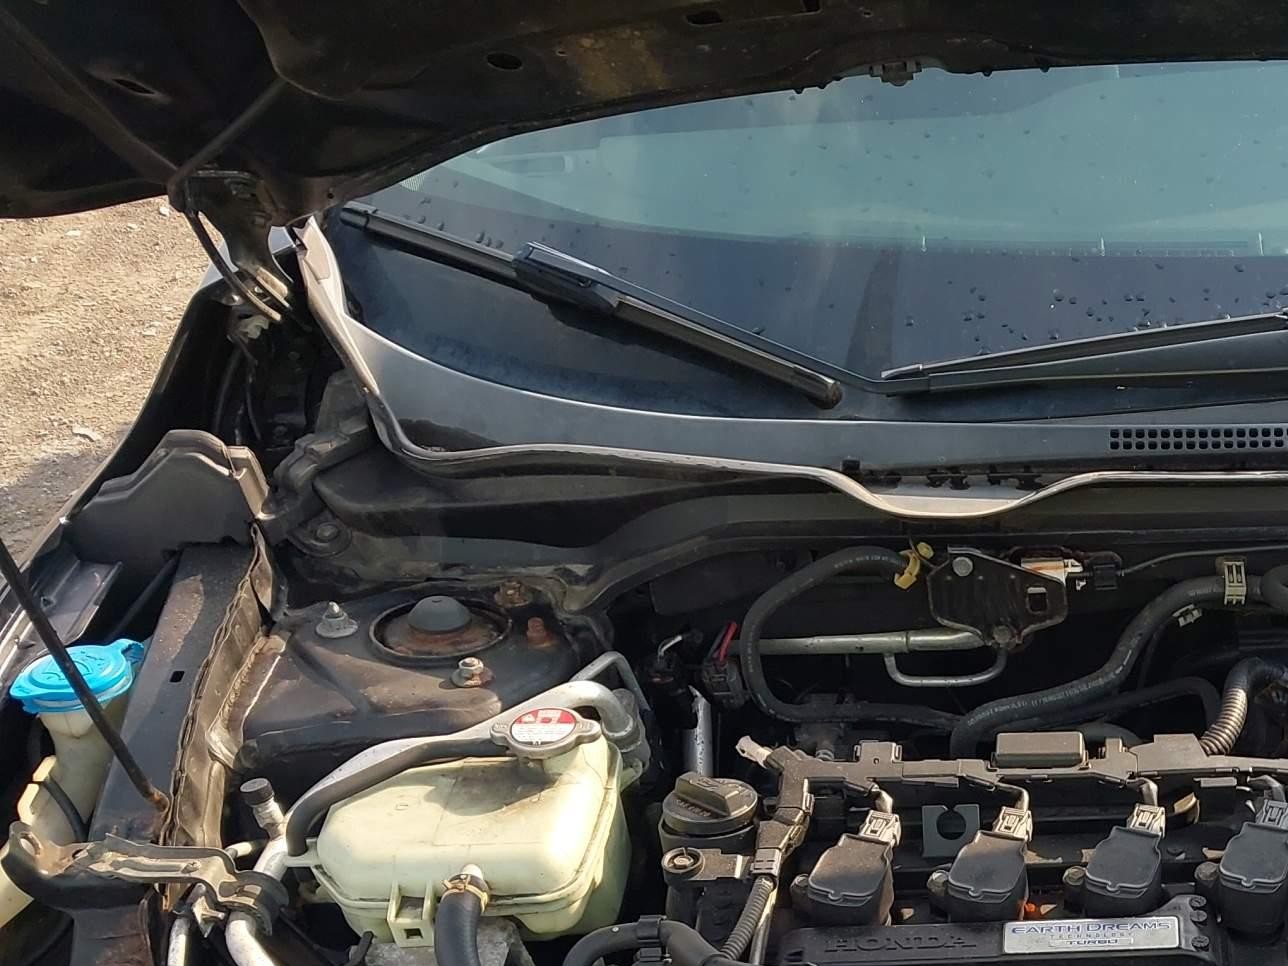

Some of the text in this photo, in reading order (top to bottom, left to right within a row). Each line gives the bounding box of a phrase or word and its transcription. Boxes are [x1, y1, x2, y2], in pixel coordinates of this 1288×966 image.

[1011, 921, 1170, 934] EARTH DREAMS
[824, 935, 977, 953] HONDA
[1067, 938, 1119, 946] TURBO
